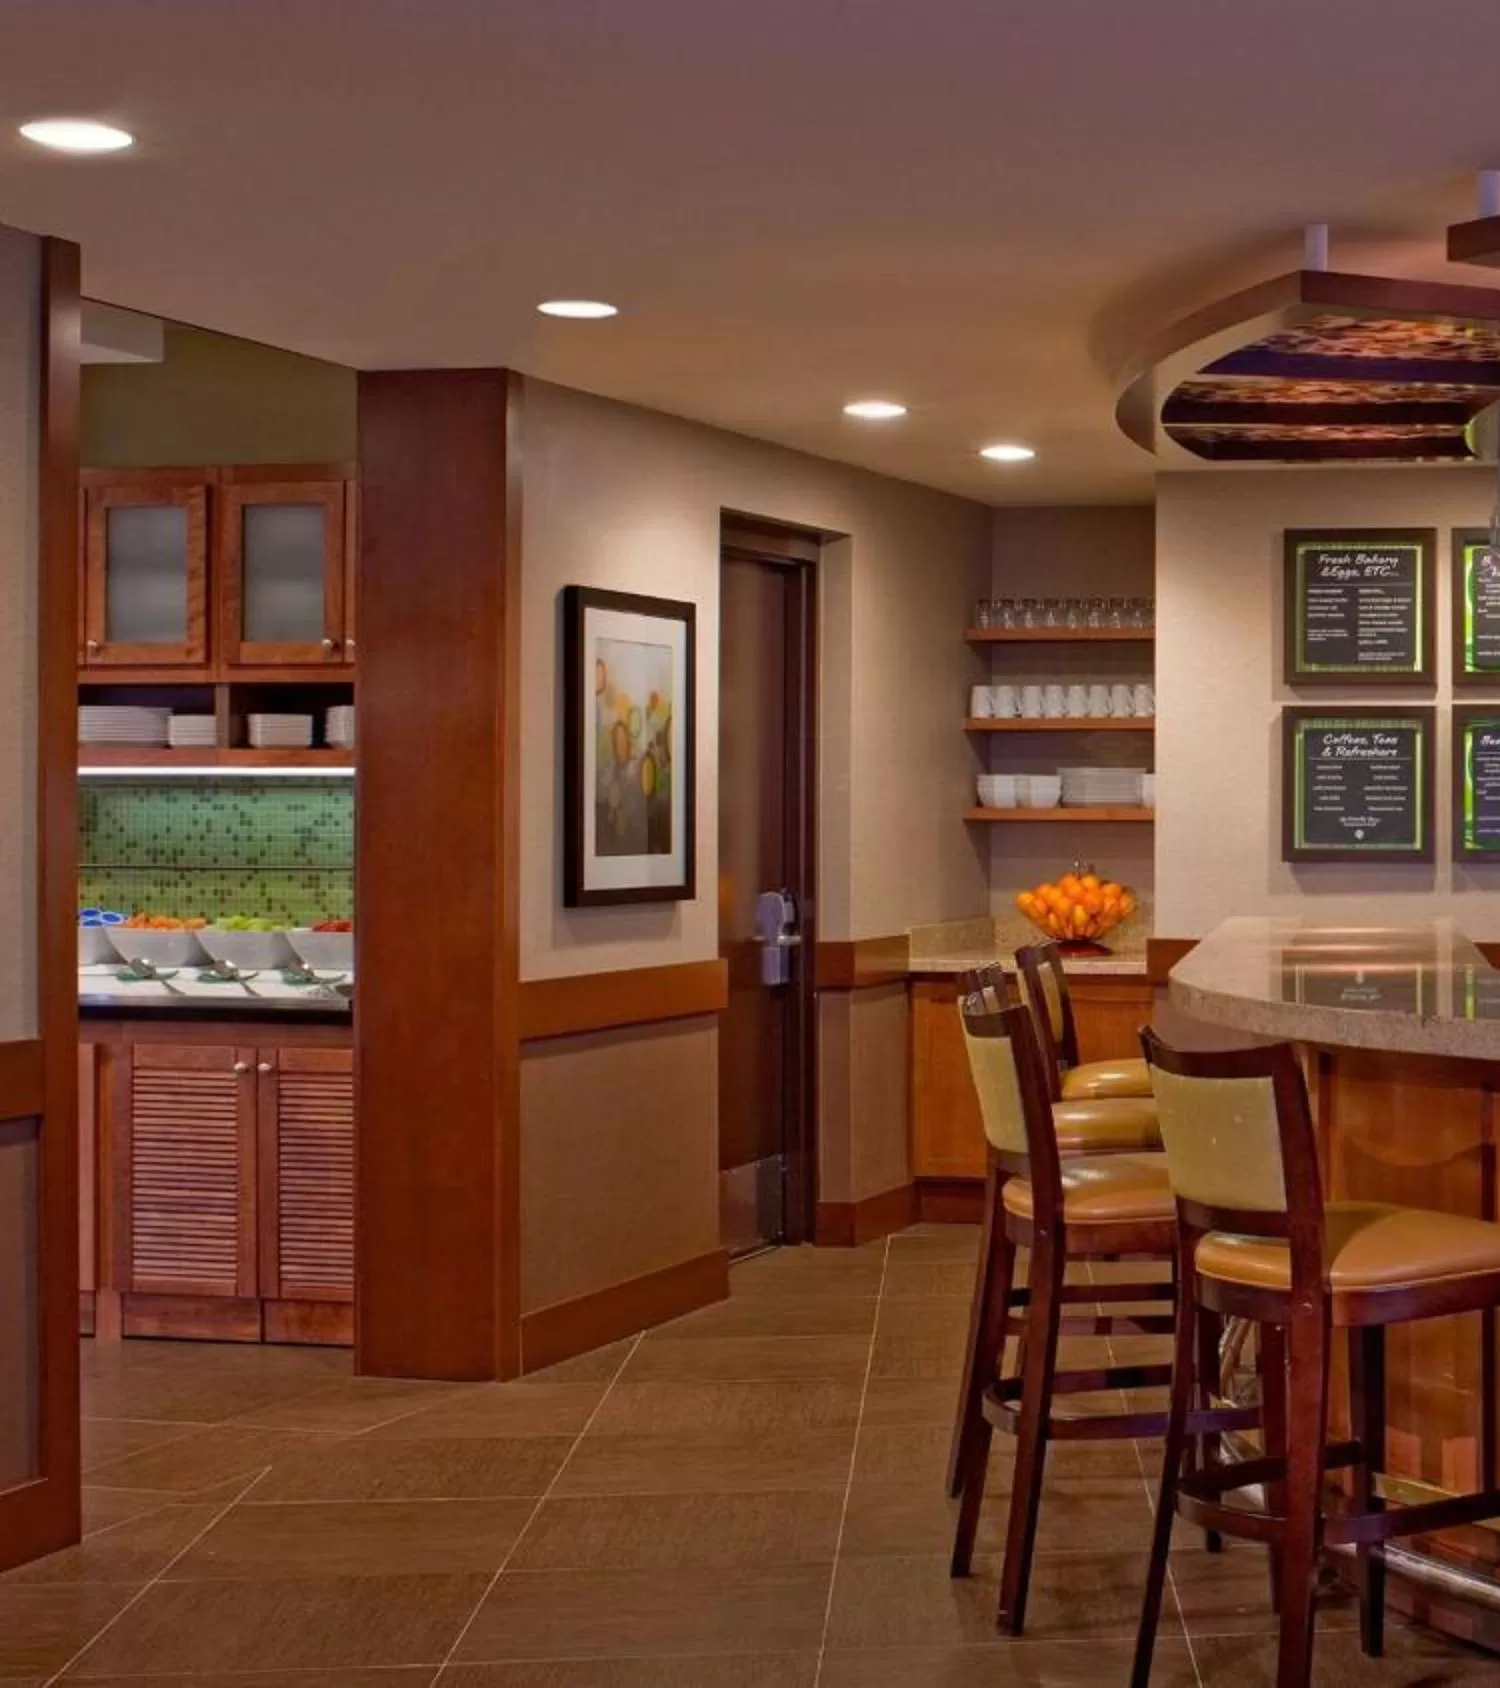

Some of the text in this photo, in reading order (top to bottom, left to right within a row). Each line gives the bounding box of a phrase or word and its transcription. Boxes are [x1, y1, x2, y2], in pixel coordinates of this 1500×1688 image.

[1318, 553, 1400, 568] Fresh Bakery
[1321, 746, 1332, 757] &
